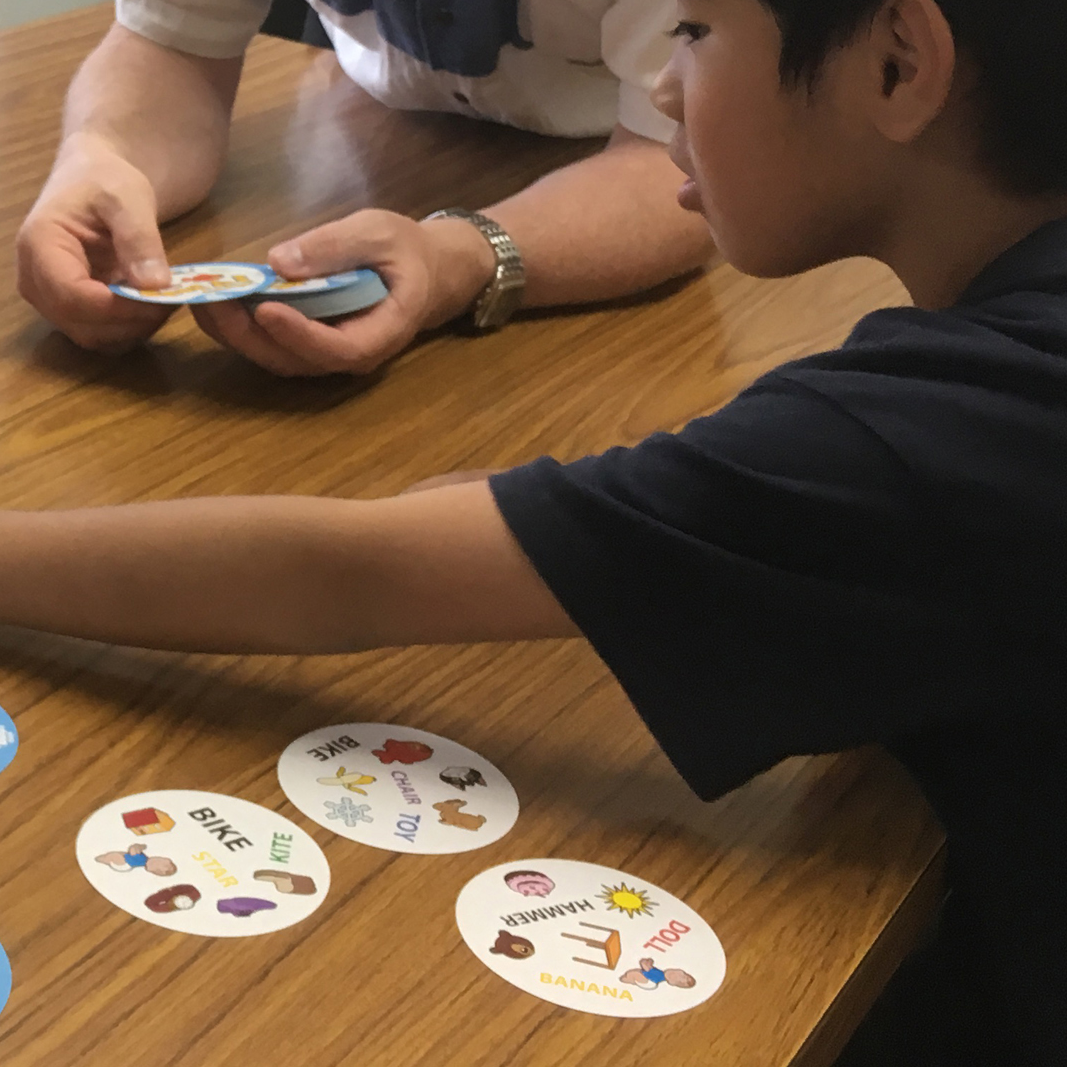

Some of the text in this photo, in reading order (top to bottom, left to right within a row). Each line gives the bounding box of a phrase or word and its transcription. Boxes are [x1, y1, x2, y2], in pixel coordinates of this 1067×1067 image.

[306, 735, 361, 762] BIKE
[390, 770, 422, 806] CHAIR
[187, 806, 254, 853] BIKE
[393, 812, 422, 843] TOY
[269, 831, 293, 864] KITE
[192, 850, 239, 888] STAR
[499, 899, 595, 927] HAMMER
[643, 919, 691, 953] DOLL
[539, 972, 634, 1002] BANANA
